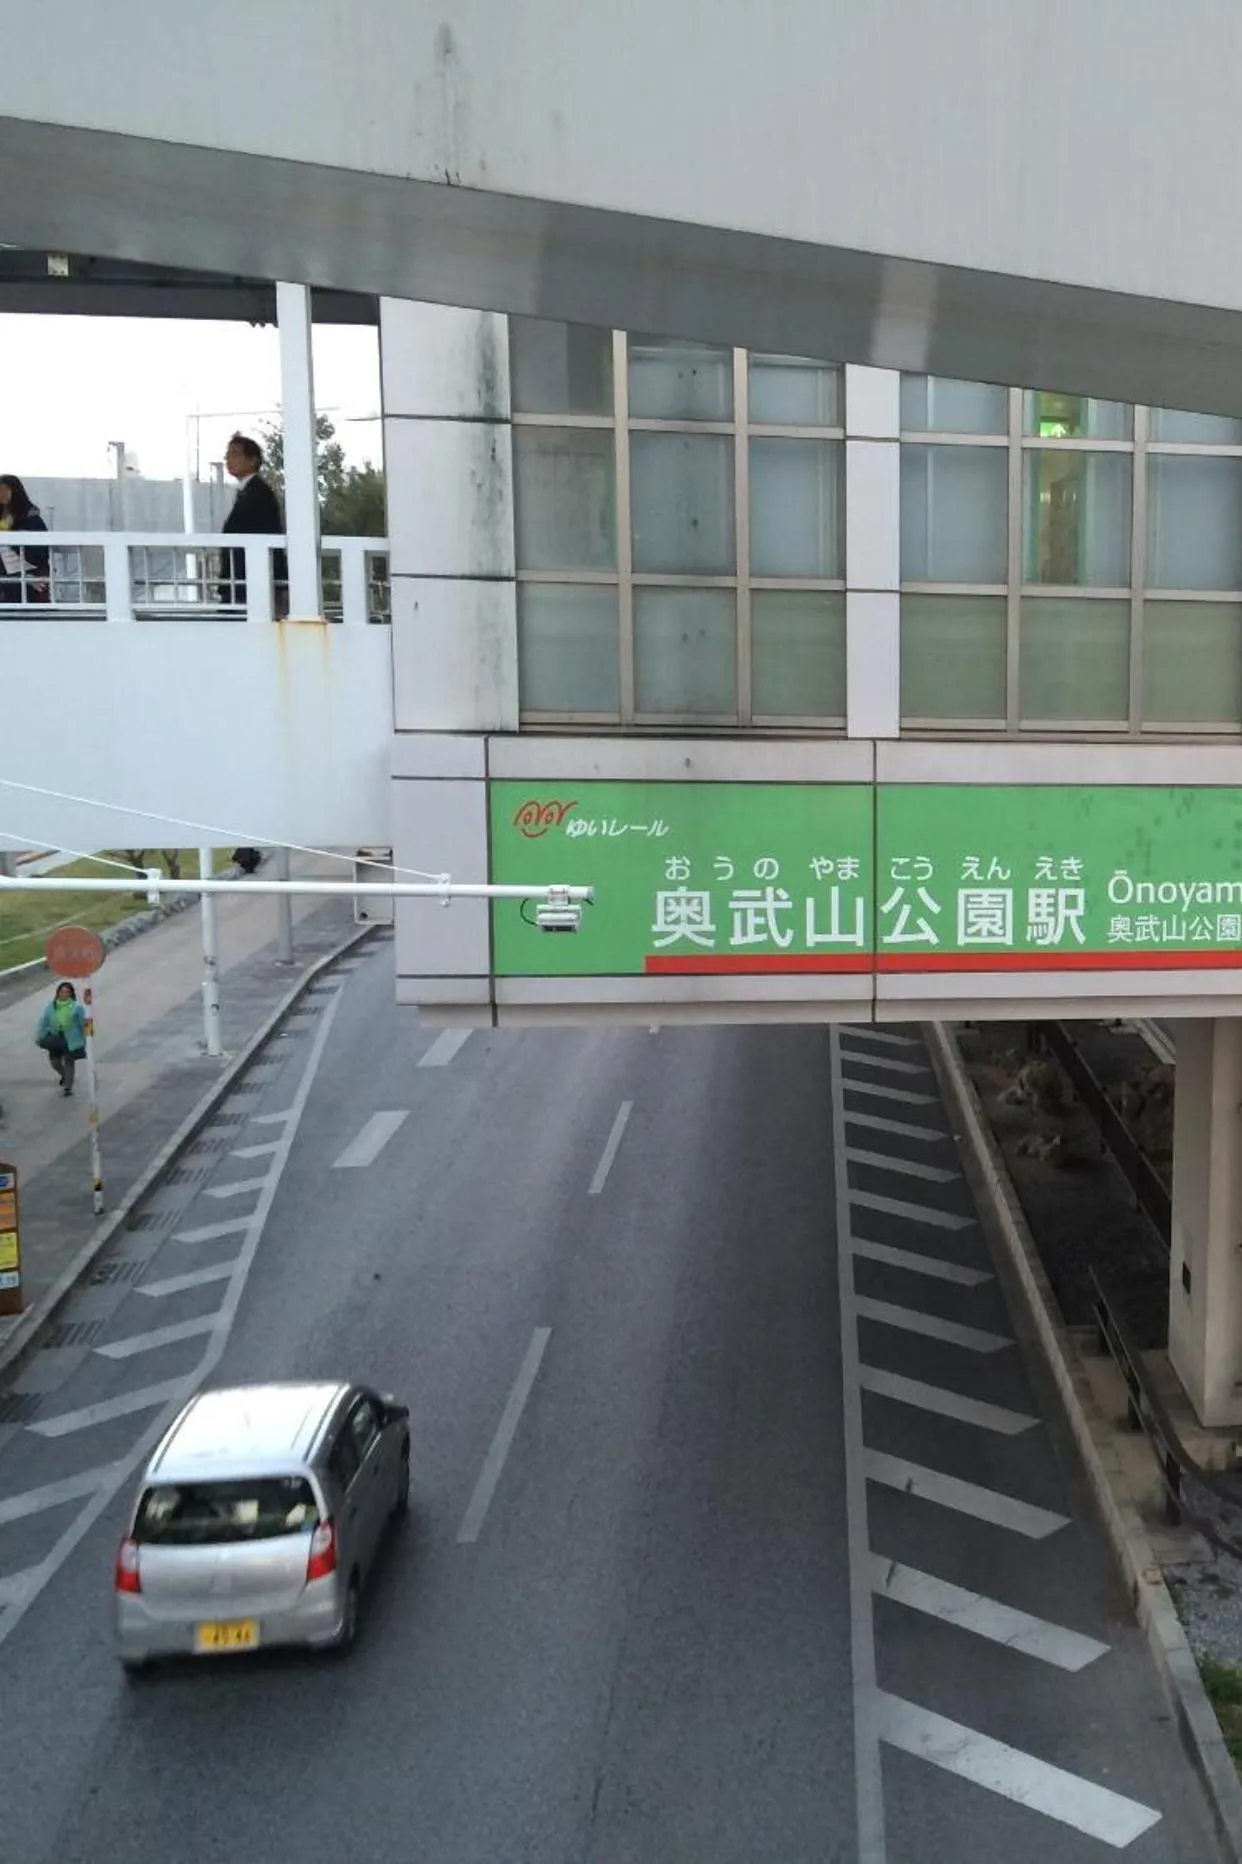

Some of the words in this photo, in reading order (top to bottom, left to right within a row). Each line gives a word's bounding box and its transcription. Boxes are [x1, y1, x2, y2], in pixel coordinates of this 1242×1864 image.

[565, 817, 670, 838] ゆいレール
[651, 885, 1086, 948] 奥武山公園駅
